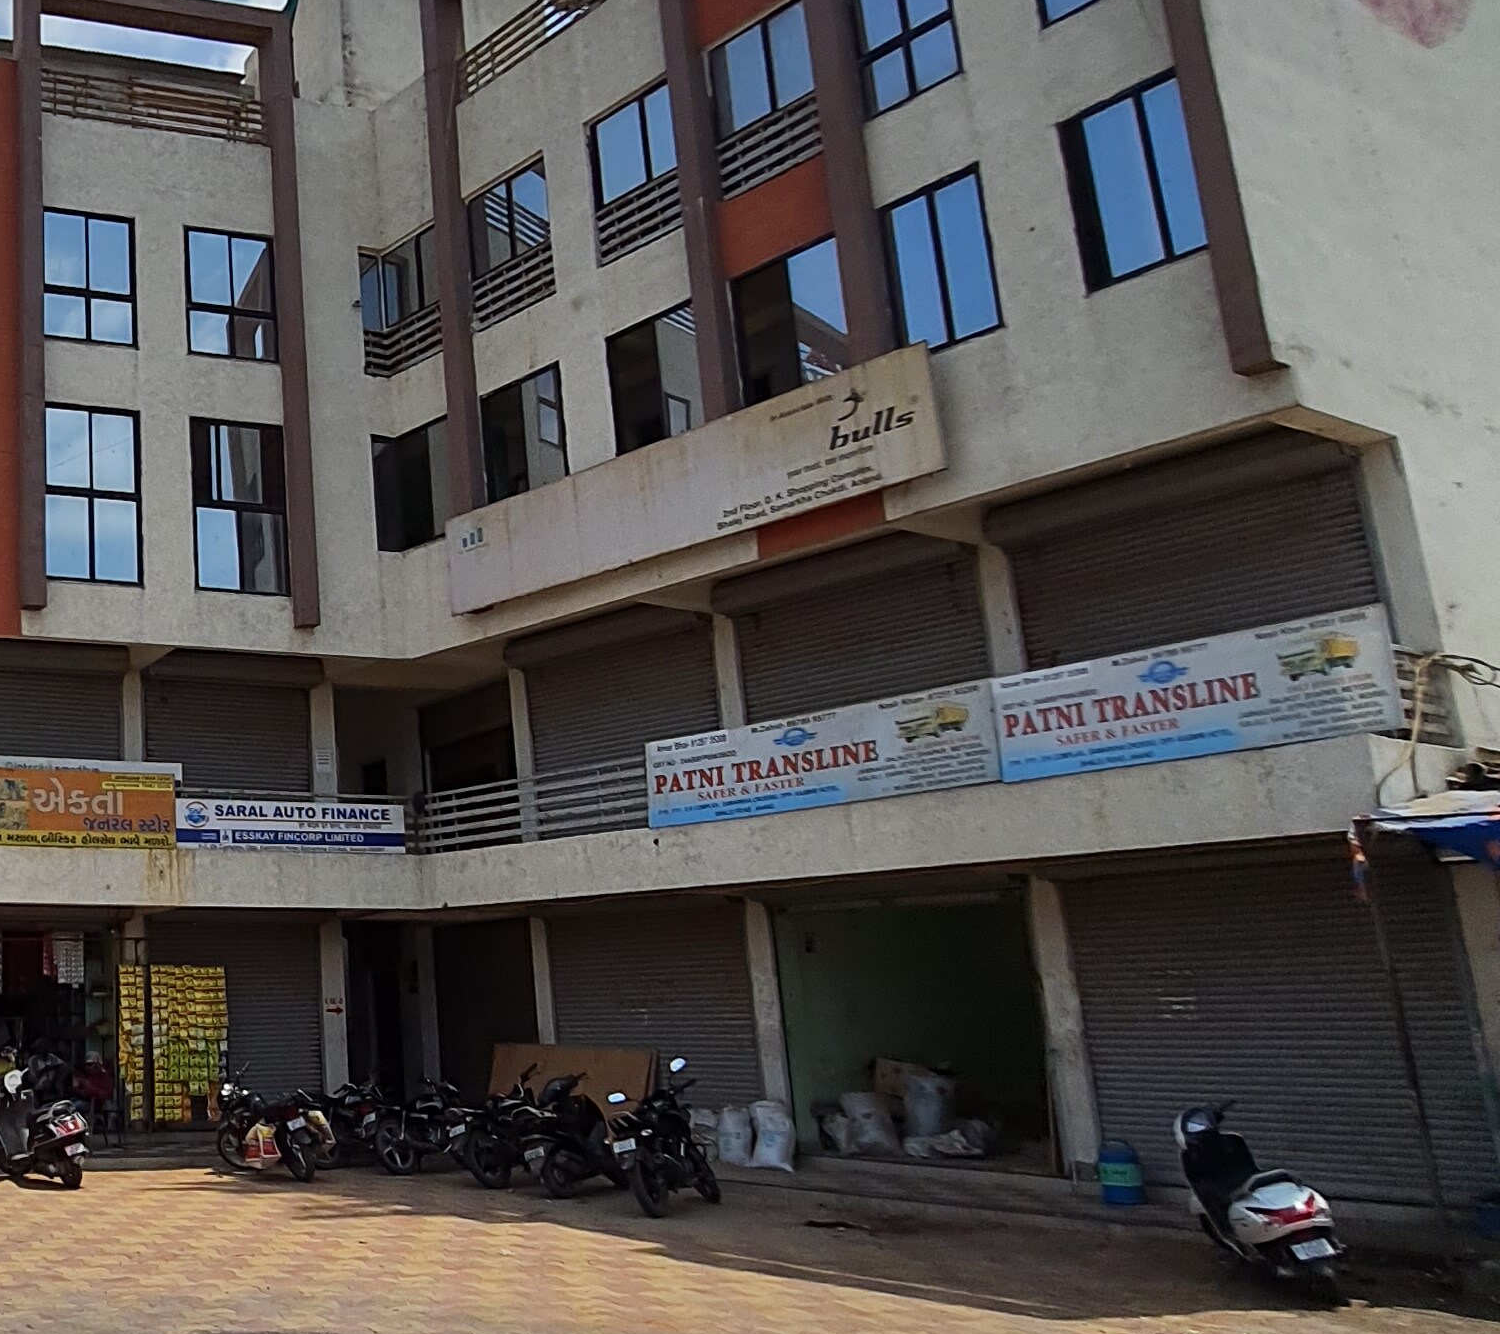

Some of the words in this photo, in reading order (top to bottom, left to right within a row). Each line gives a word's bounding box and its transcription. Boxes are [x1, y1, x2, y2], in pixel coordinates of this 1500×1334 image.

[829, 406, 916, 450] bulls
[1003, 702, 1088, 738] PATNI
[1092, 672, 1260, 724] TRANSLINE
[1056, 729, 1100, 746] SAFER
[1122, 718, 1180, 738] FASTER
[654, 765, 726, 795] PATNI
[731, 740, 880, 784] TRANSLINE
[32, 777, 124, 816] એકતા
[697, 787, 736, 802] SAFER
[755, 777, 806, 793] FASTER
[83, 816, 133, 832] જનરલ
[138, 814, 171, 833] સ્ટોર
[214, 804, 269, 818] SARAL
[273, 806, 319, 819] AUTO
[321, 807, 391, 821] FINANCE
[234, 831, 276, 841] ESSKAY
[278, 832, 322, 843] FINCORP
[325, 834, 365, 843] LIMITED
